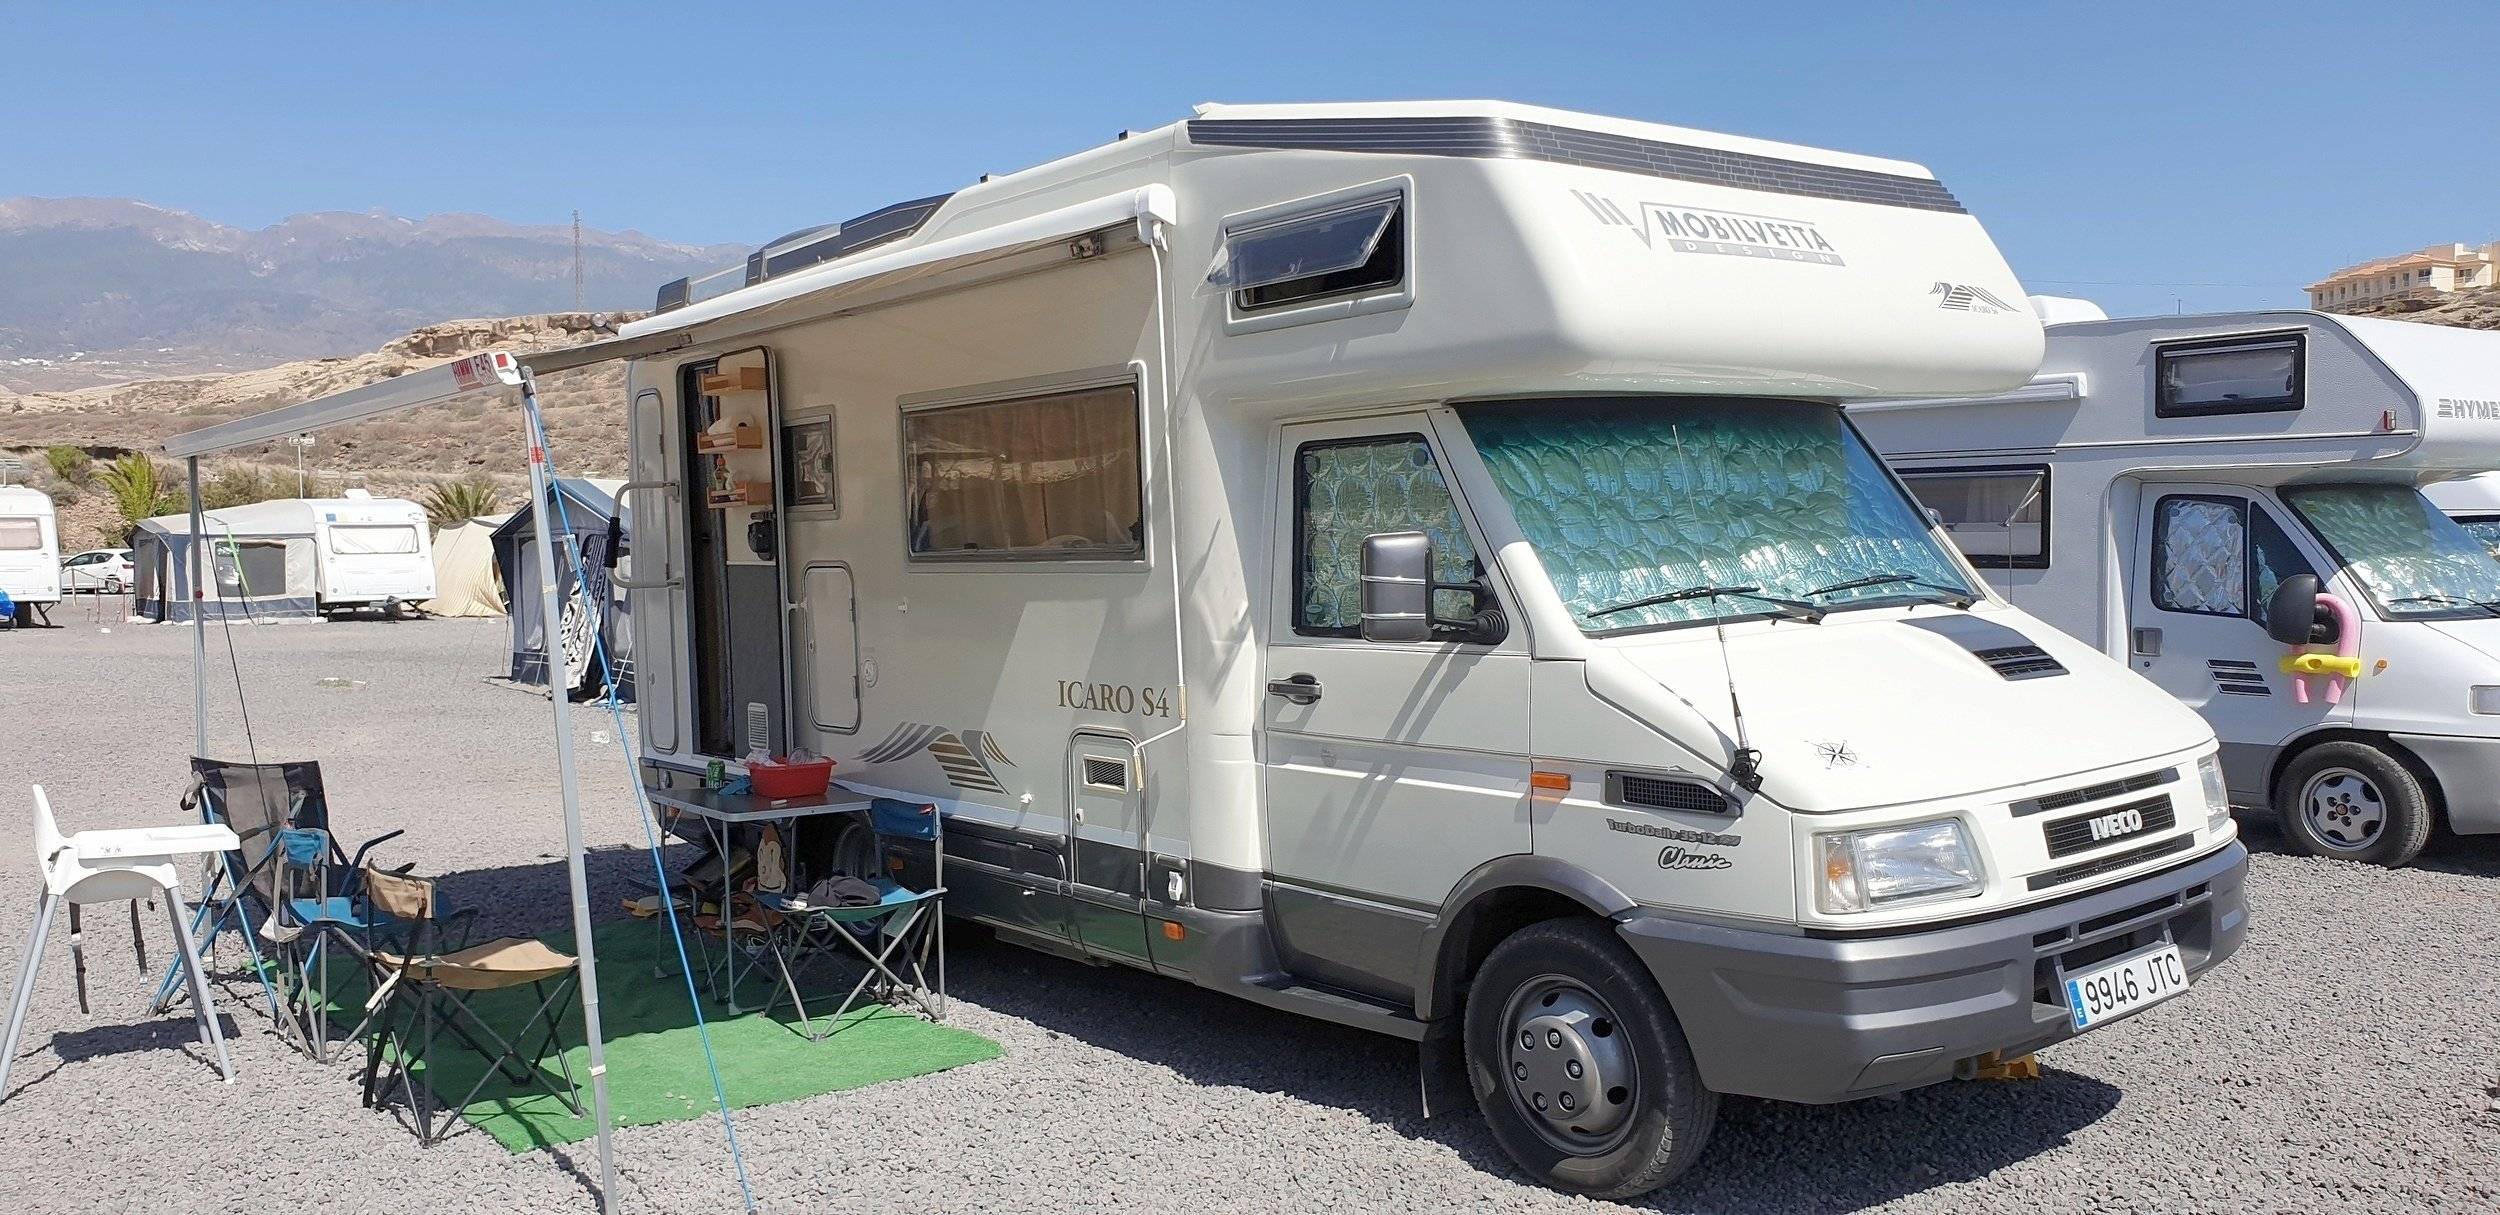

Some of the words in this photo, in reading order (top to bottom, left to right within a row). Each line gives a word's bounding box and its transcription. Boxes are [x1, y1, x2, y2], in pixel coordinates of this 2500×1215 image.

[1655, 209, 1835, 251] MOBILVETTA
[1684, 243, 1833, 263] DESIGN
[2453, 399, 2500, 419] HYME
[1057, 680, 1135, 714] ICARO
[1141, 687, 1170, 718] S4
[1605, 818, 1679, 840] TurboDaily
[1679, 829, 1716, 845] 35-12
[2089, 809, 2143, 841] IVECO
[2076, 1007, 2084, 1018] E
[2085, 968, 2139, 1015] 9946
[2147, 953, 2181, 995] JTC
